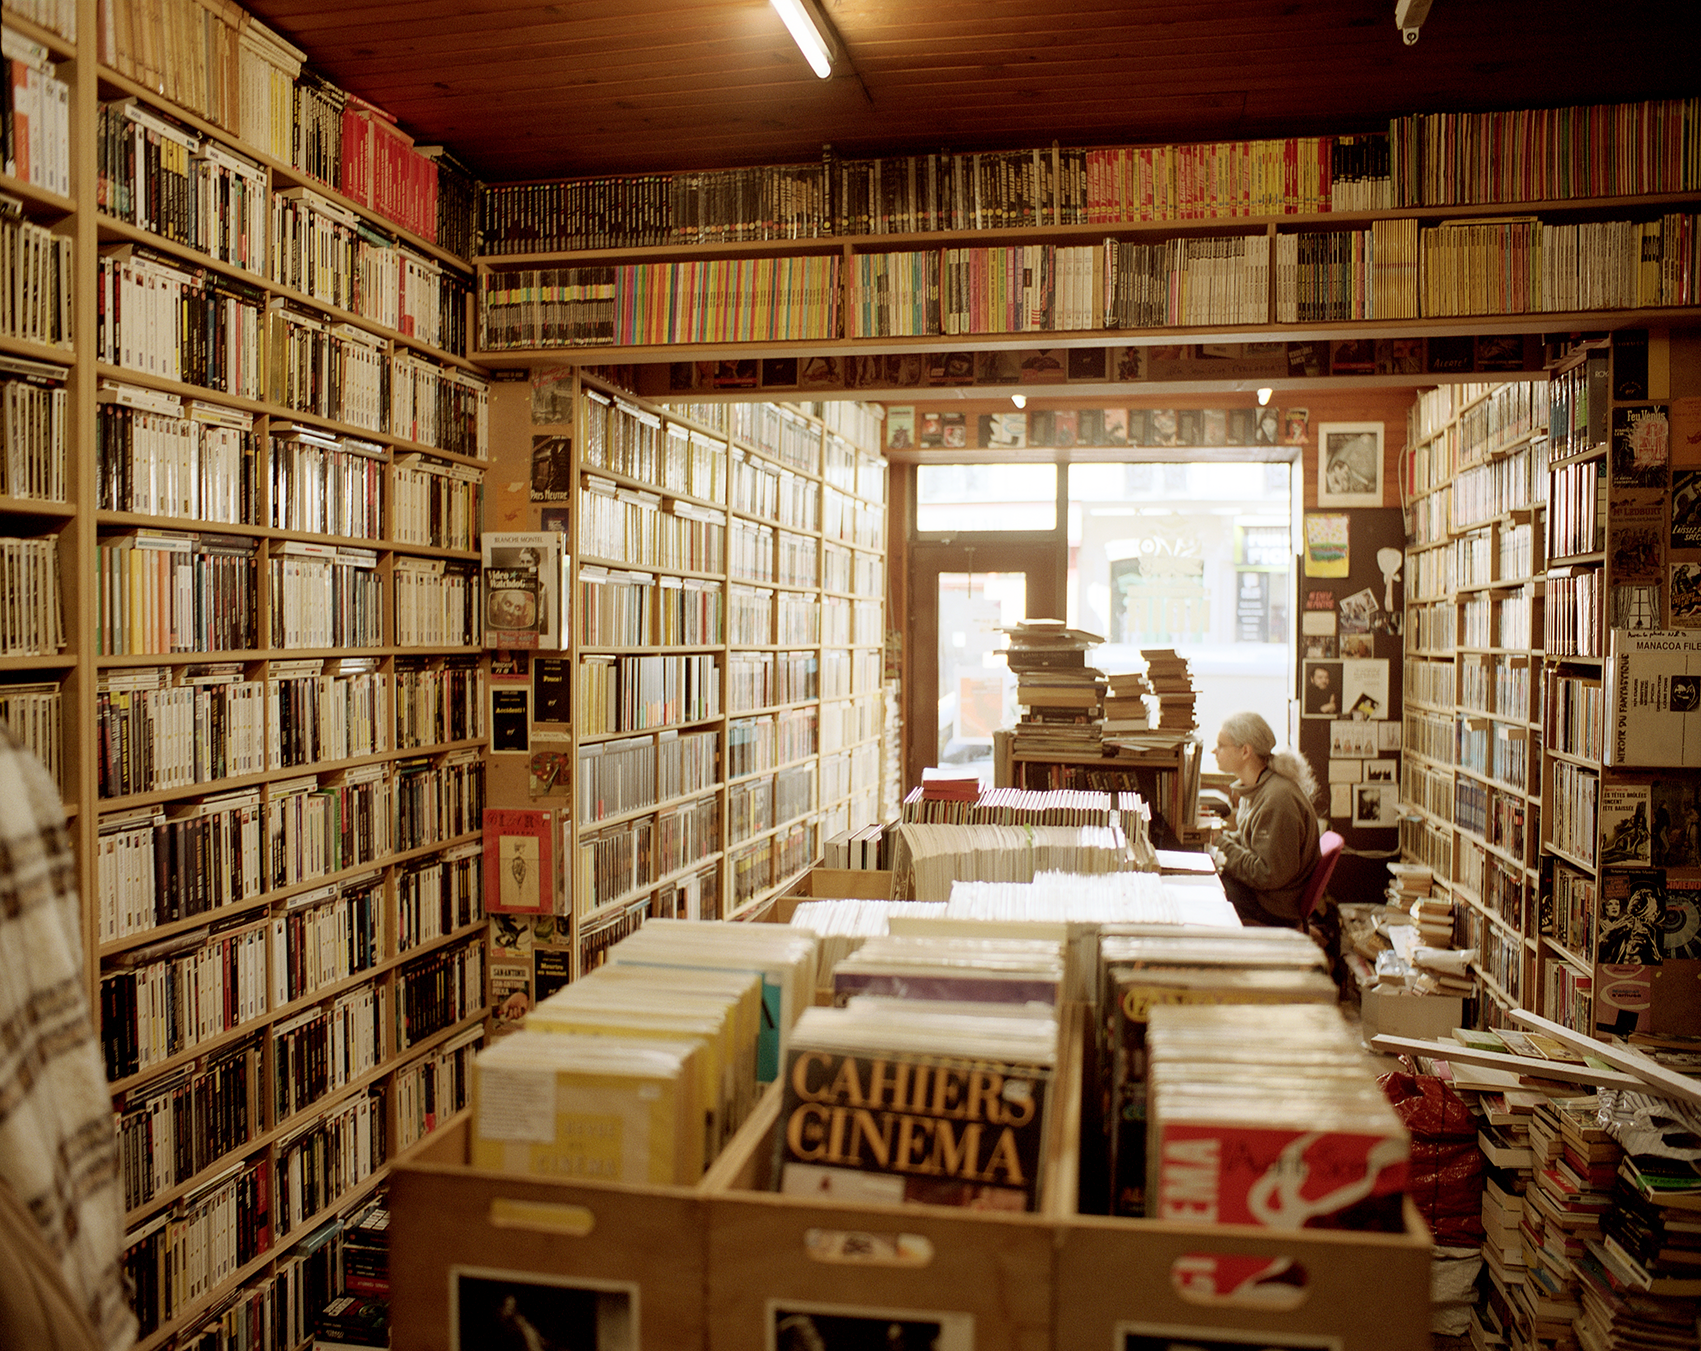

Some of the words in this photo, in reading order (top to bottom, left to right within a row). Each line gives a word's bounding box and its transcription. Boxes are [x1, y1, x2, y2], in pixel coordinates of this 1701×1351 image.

[1627, 410, 1640, 421] Feu
[544, 490, 568, 500] NEUTRE
[488, 570, 509, 580] Video
[1637, 642, 1681, 650] MANACOA
[1619, 653, 1629, 713] FANTASTIQUE
[1618, 715, 1628, 728] DU
[792, 1051, 1036, 1127] CAHIERS
[787, 1102, 1027, 1186] CINEMA
